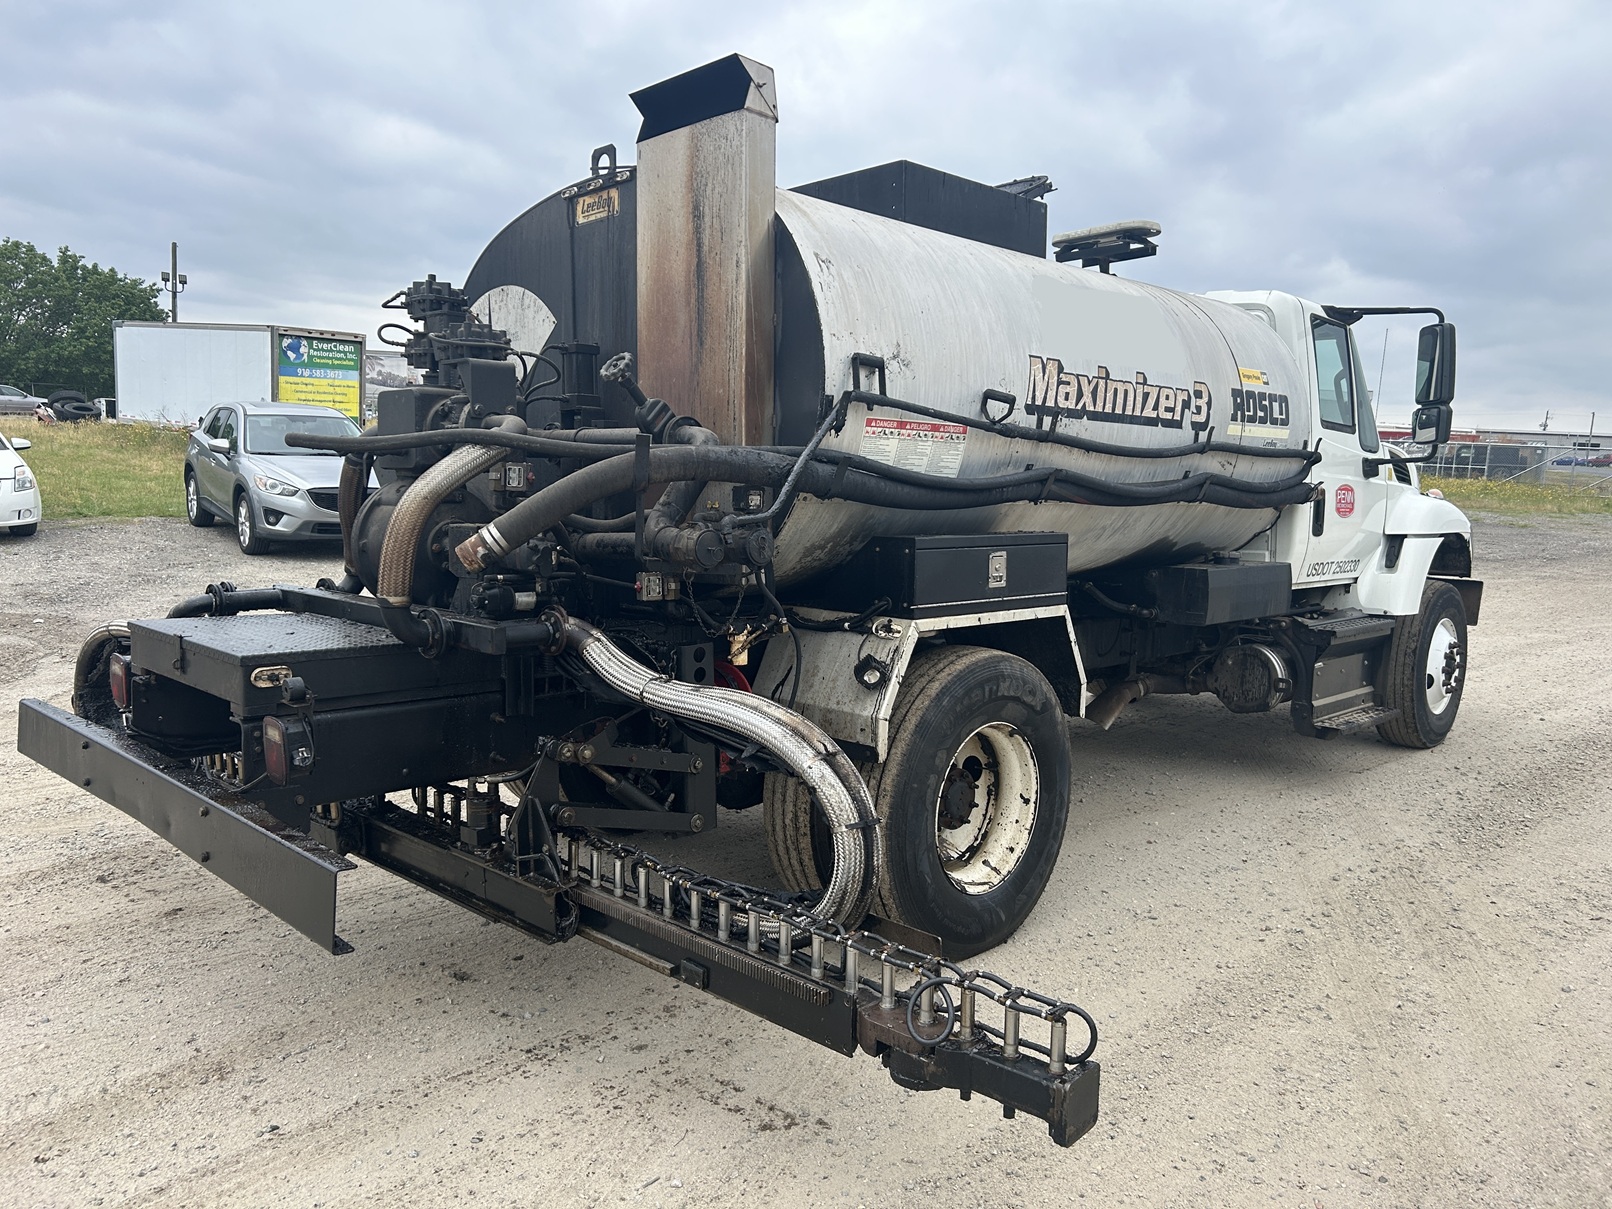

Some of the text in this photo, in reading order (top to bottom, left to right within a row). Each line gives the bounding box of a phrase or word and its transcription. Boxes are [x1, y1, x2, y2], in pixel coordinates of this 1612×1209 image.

[312, 340, 355, 352] EverClean
[309, 349, 358, 360] Restoration, Inc.
[1230, 387, 1290, 427] ROSCO
[876, 419, 898, 428] DANGER
[910, 422, 932, 431] PELIGRO
[944, 425, 963, 433] DANGER
[1337, 490, 1354, 503] PENN
[1306, 561, 1335, 577] USDOT
